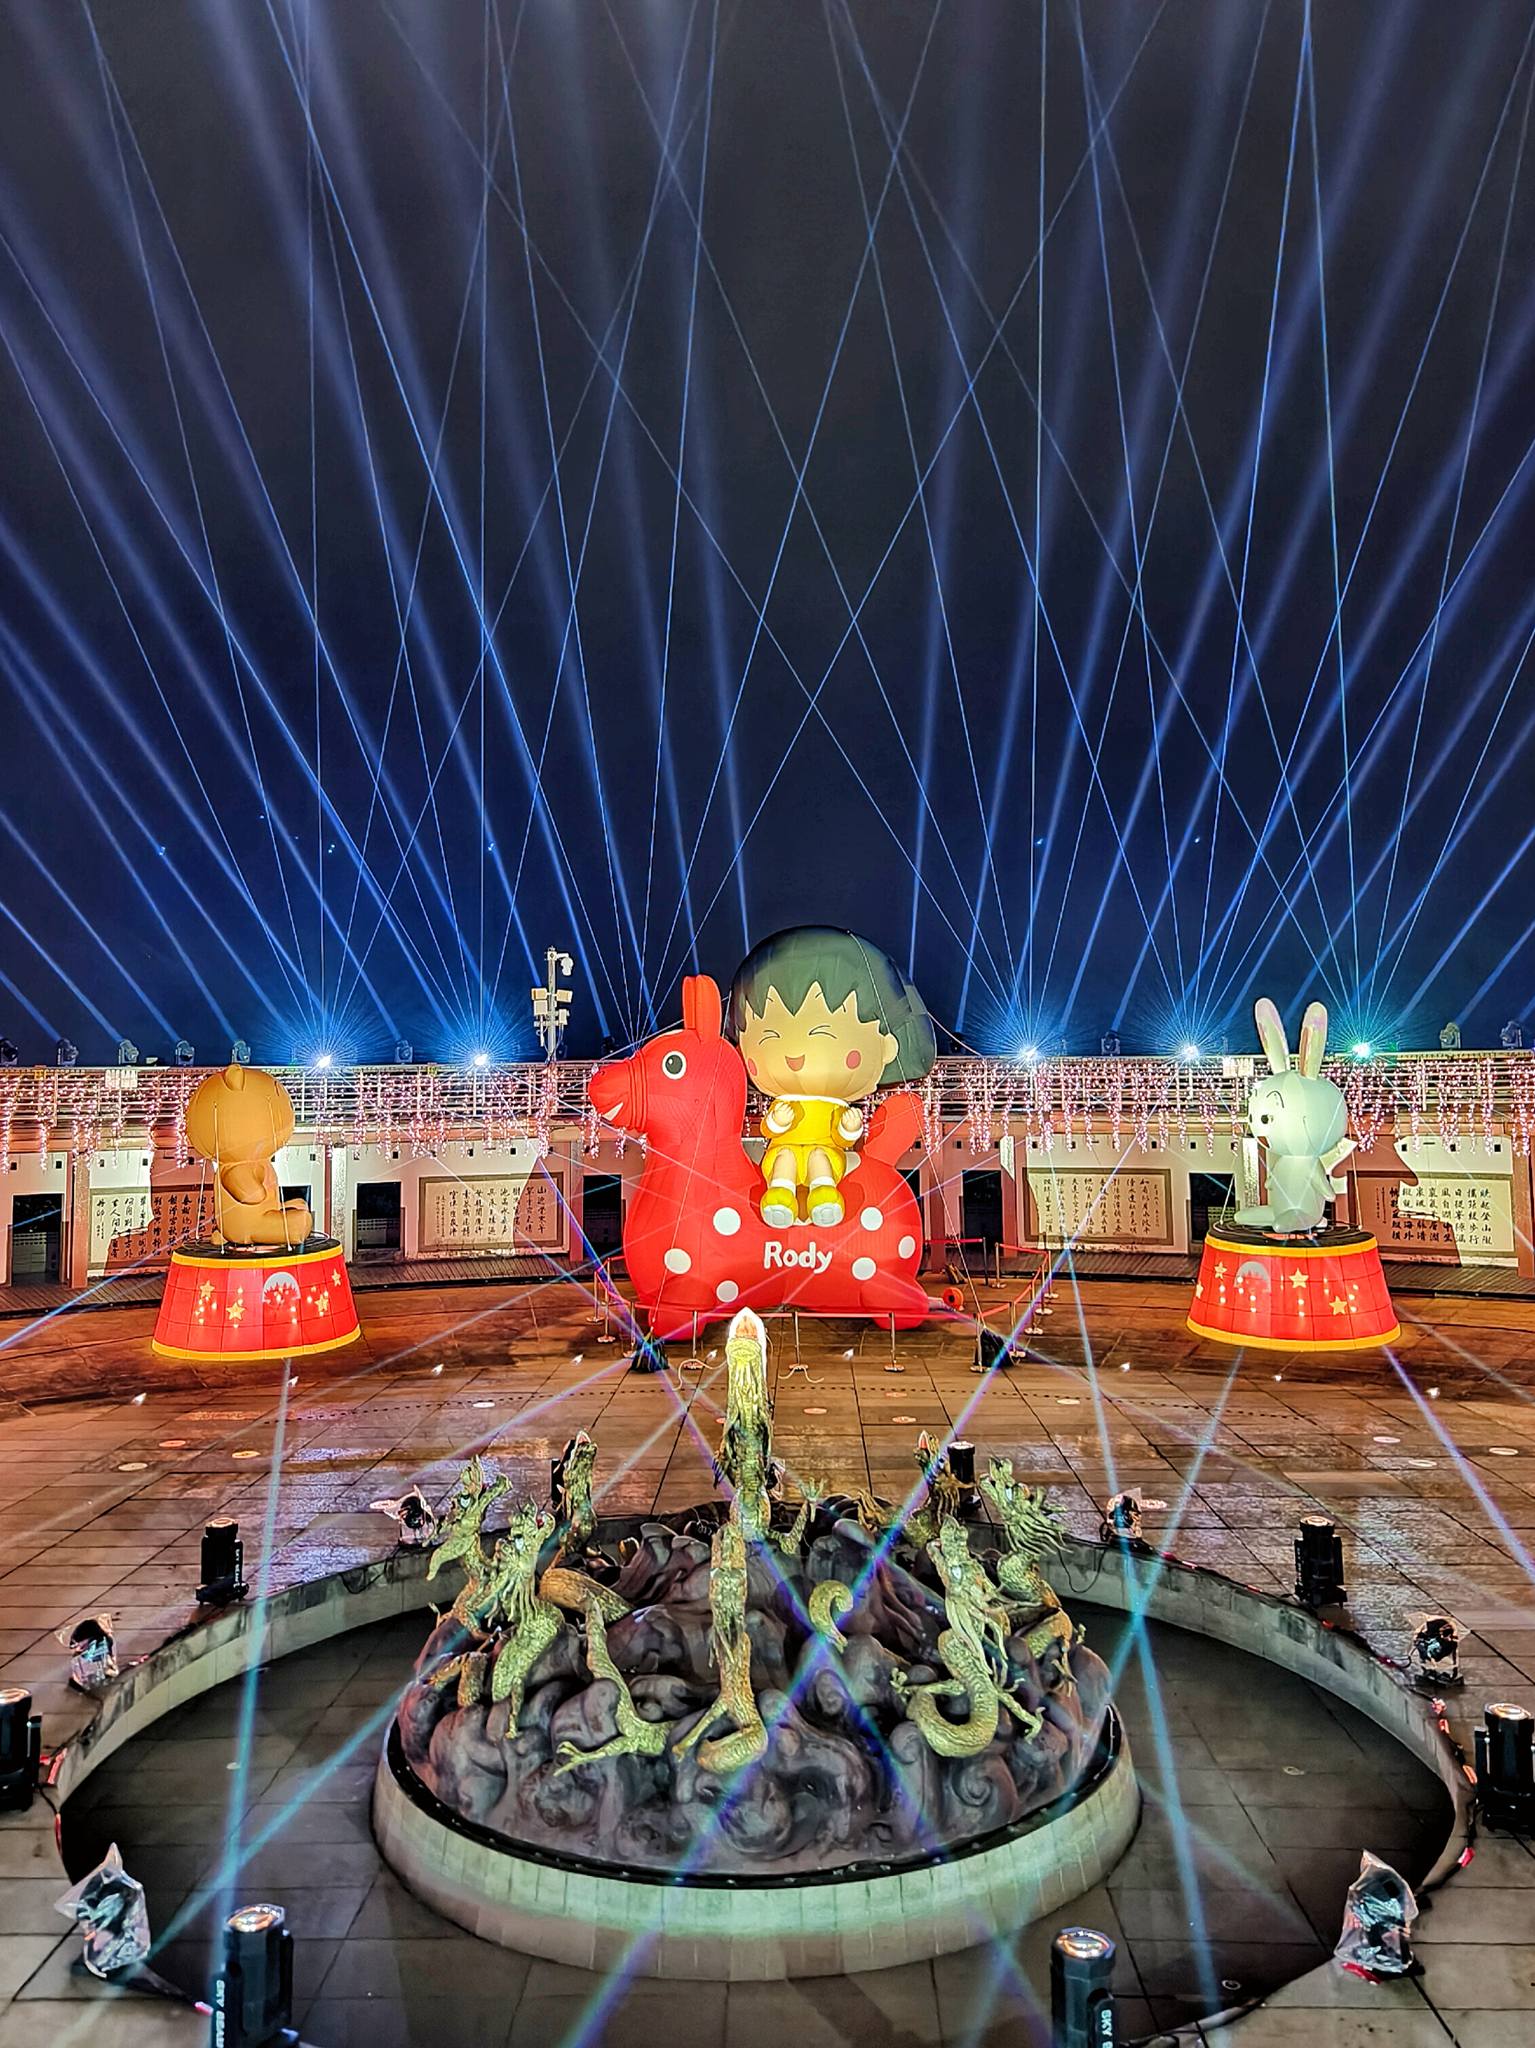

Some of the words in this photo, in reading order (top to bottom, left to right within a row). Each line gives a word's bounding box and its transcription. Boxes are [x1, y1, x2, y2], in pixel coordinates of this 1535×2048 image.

[764, 1241, 833, 1274] Rody
[216, 1980, 225, 2007] SKY
[1101, 2009, 1113, 2037] SKY
